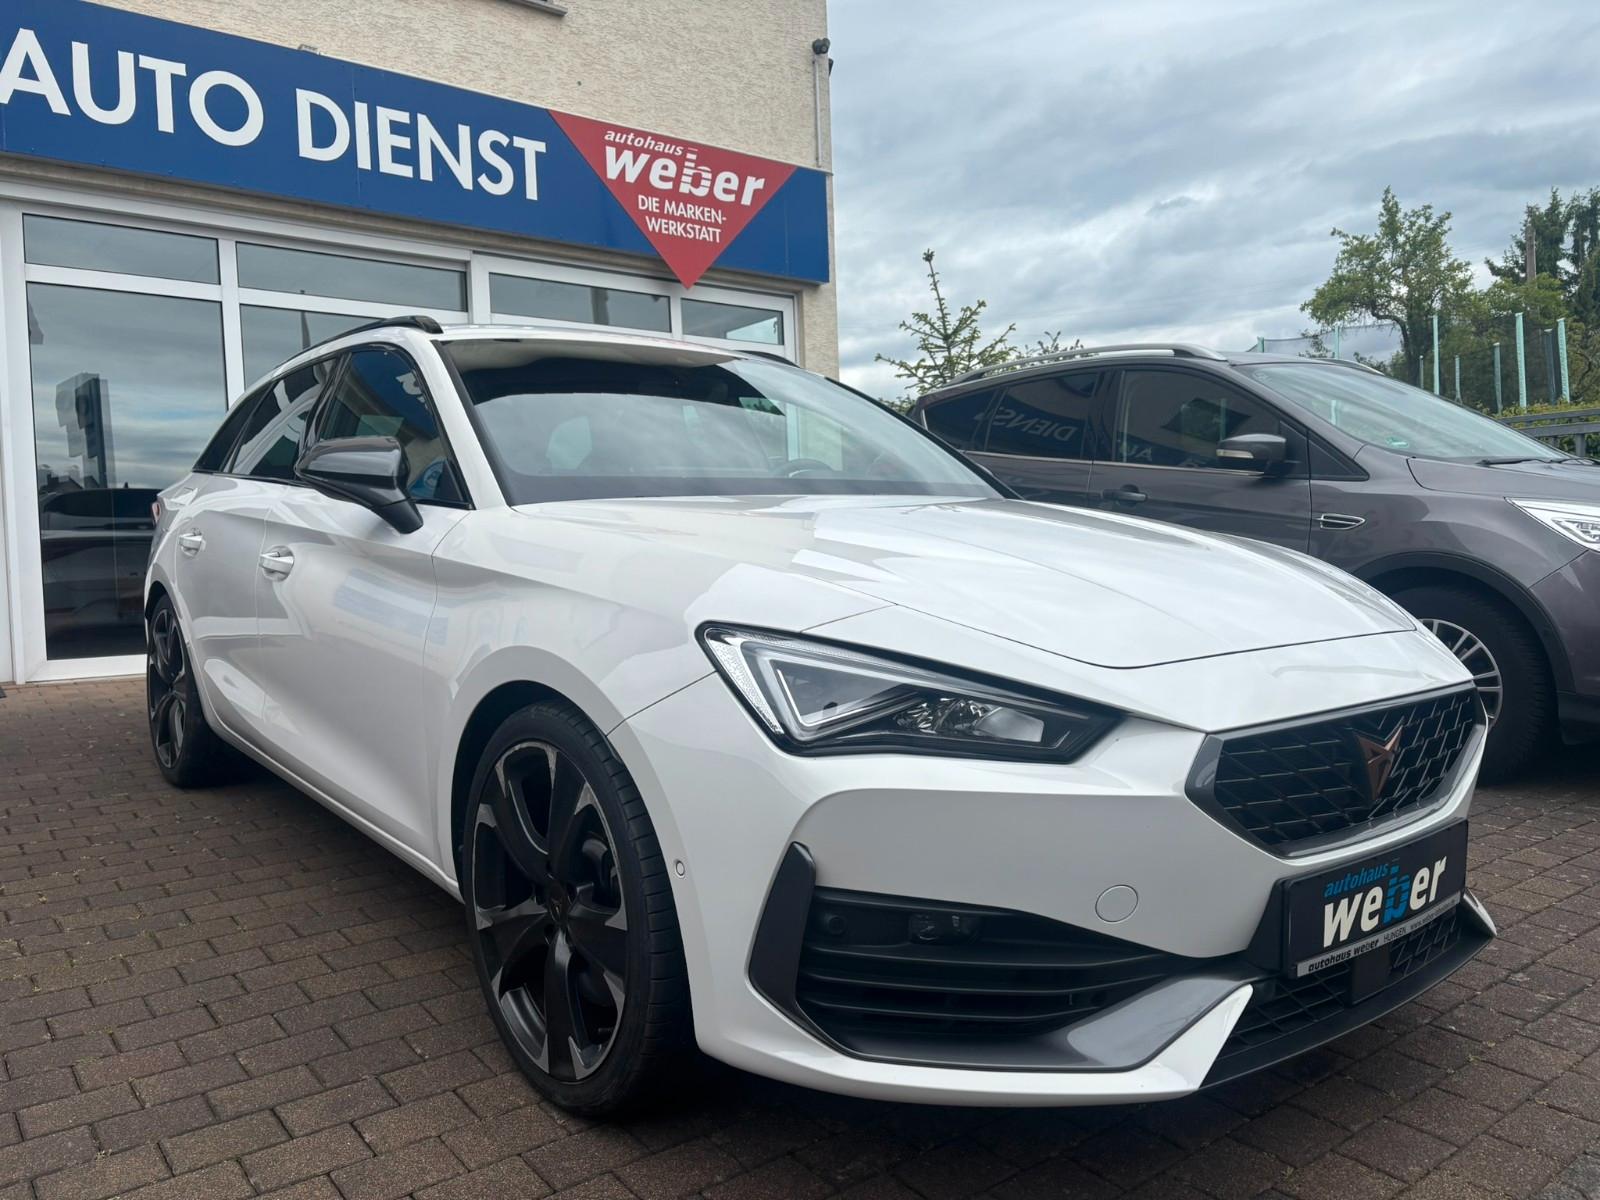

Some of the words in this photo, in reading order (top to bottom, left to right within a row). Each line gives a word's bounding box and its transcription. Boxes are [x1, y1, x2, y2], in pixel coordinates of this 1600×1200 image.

[0, 28, 264, 147] AUTO
[296, 88, 547, 201] DIENST
[604, 130, 684, 156] autohaus
[604, 145, 766, 207] weber
[638, 194, 660, 213] DIE
[663, 200, 728, 225] MARKEN-
[645, 216, 722, 244] WERKSTATT
[1323, 863, 1390, 898] autohaus
[1323, 855, 1447, 949] weber
[1308, 950, 1352, 972] autohaus
